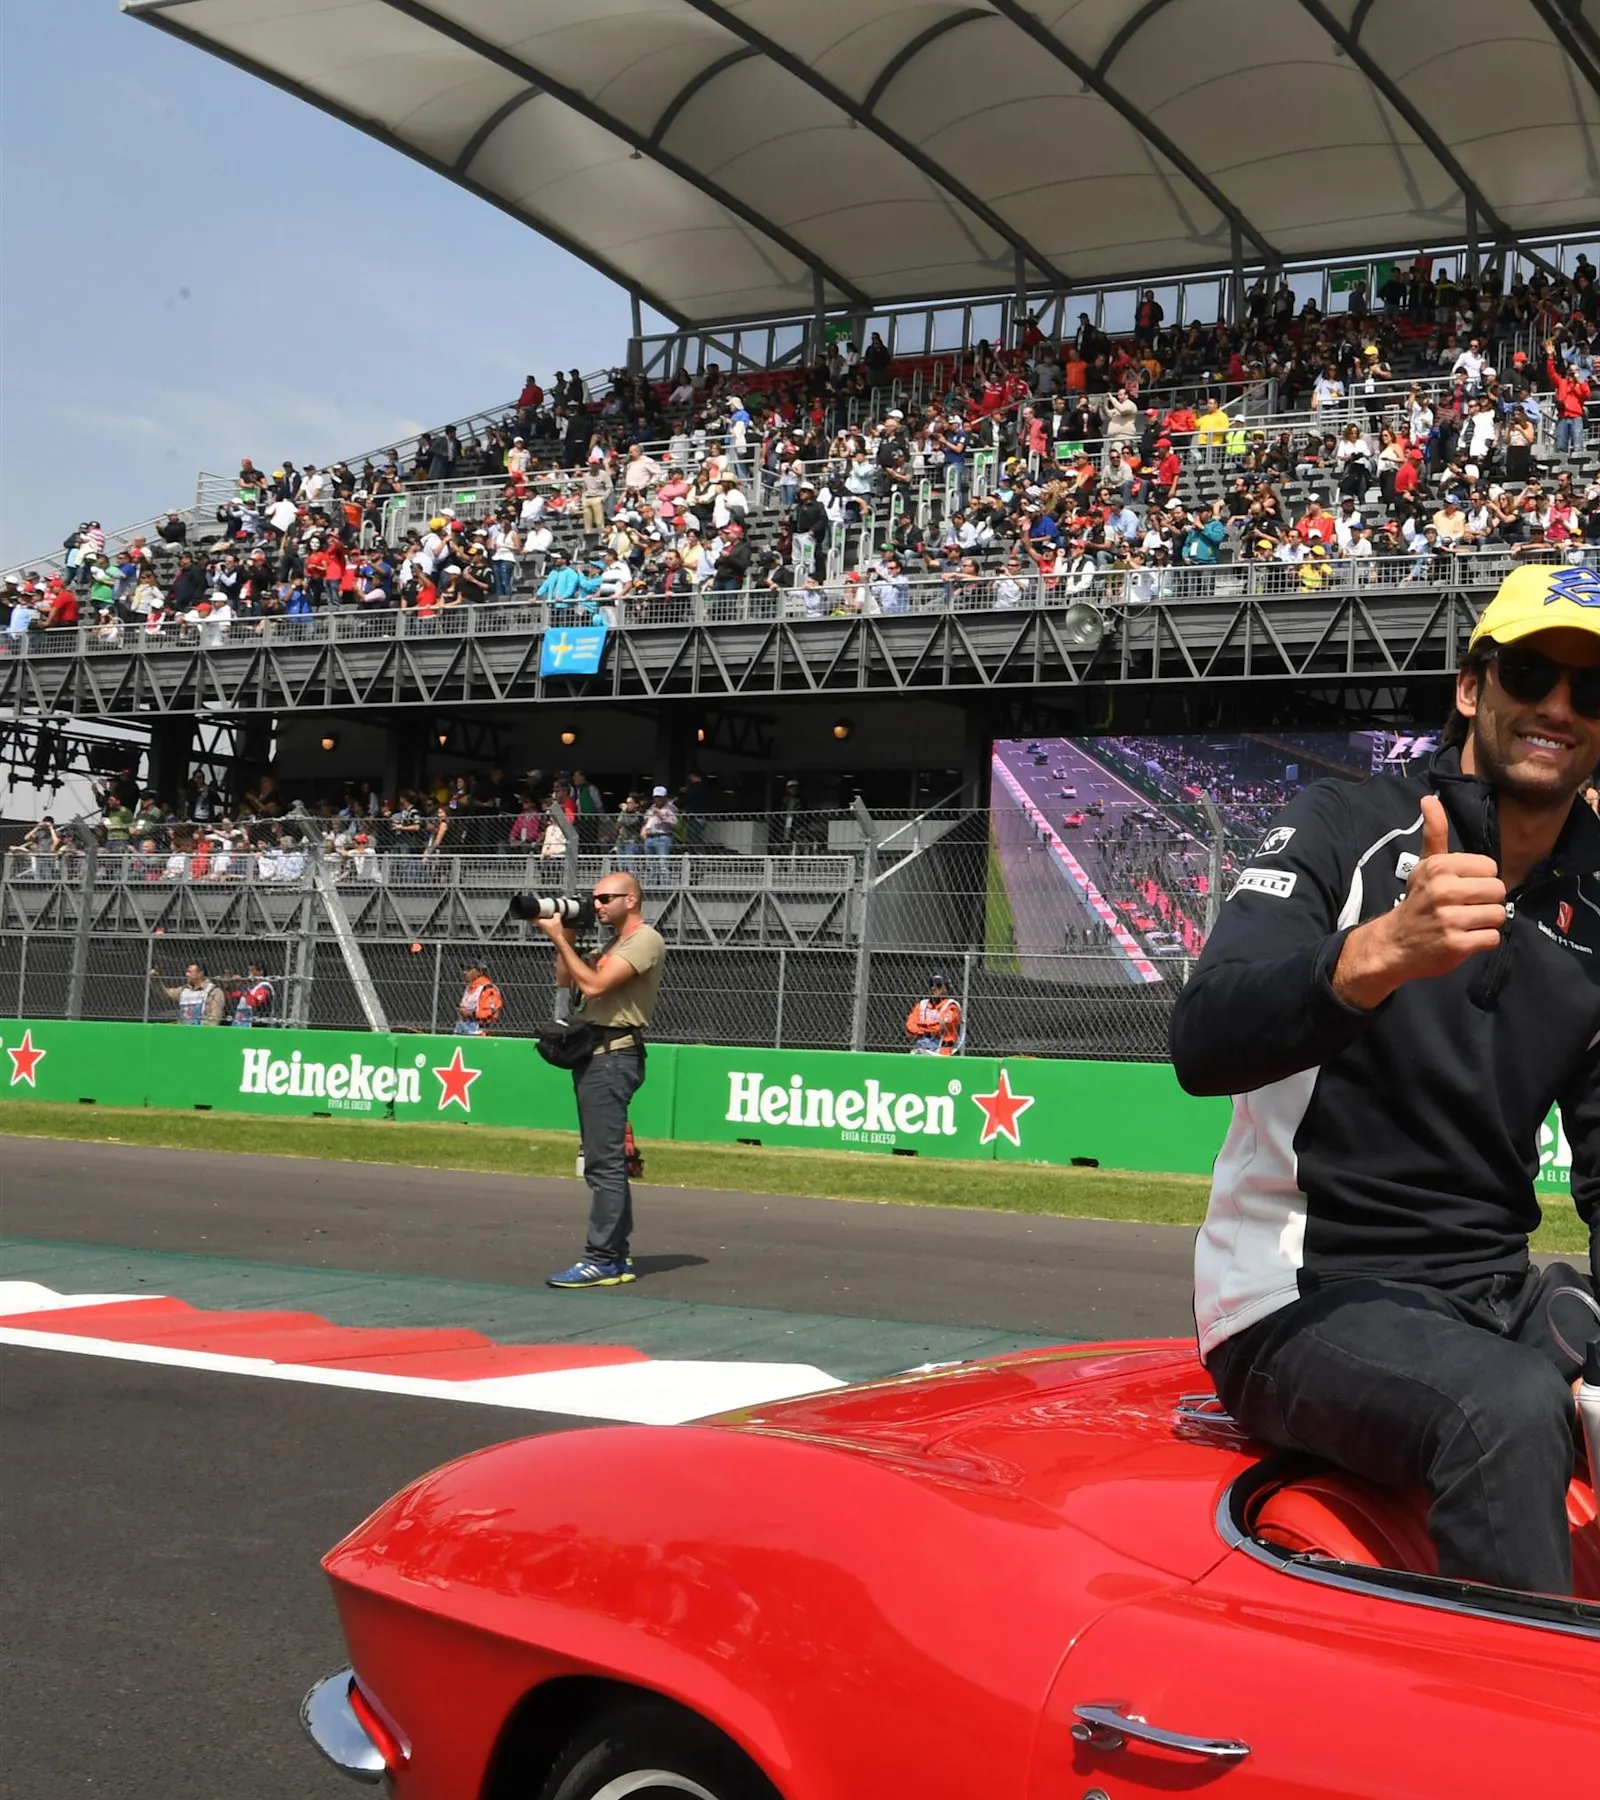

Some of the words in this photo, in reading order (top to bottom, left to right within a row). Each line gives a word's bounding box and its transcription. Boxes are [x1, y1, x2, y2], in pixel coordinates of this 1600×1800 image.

[1538, 920, 1558, 942] Sauber
[1558, 935, 1568, 947] F1
[1568, 941, 1593, 954] Team
[240, 1048, 422, 1104] Heineken
[725, 1072, 957, 1136] Heineken
[841, 1131, 860, 1142] EVITA
[861, 1132, 869, 1143] EL
[871, 1133, 896, 1145] EXCESO
[1547, 1170, 1558, 1182] EL
